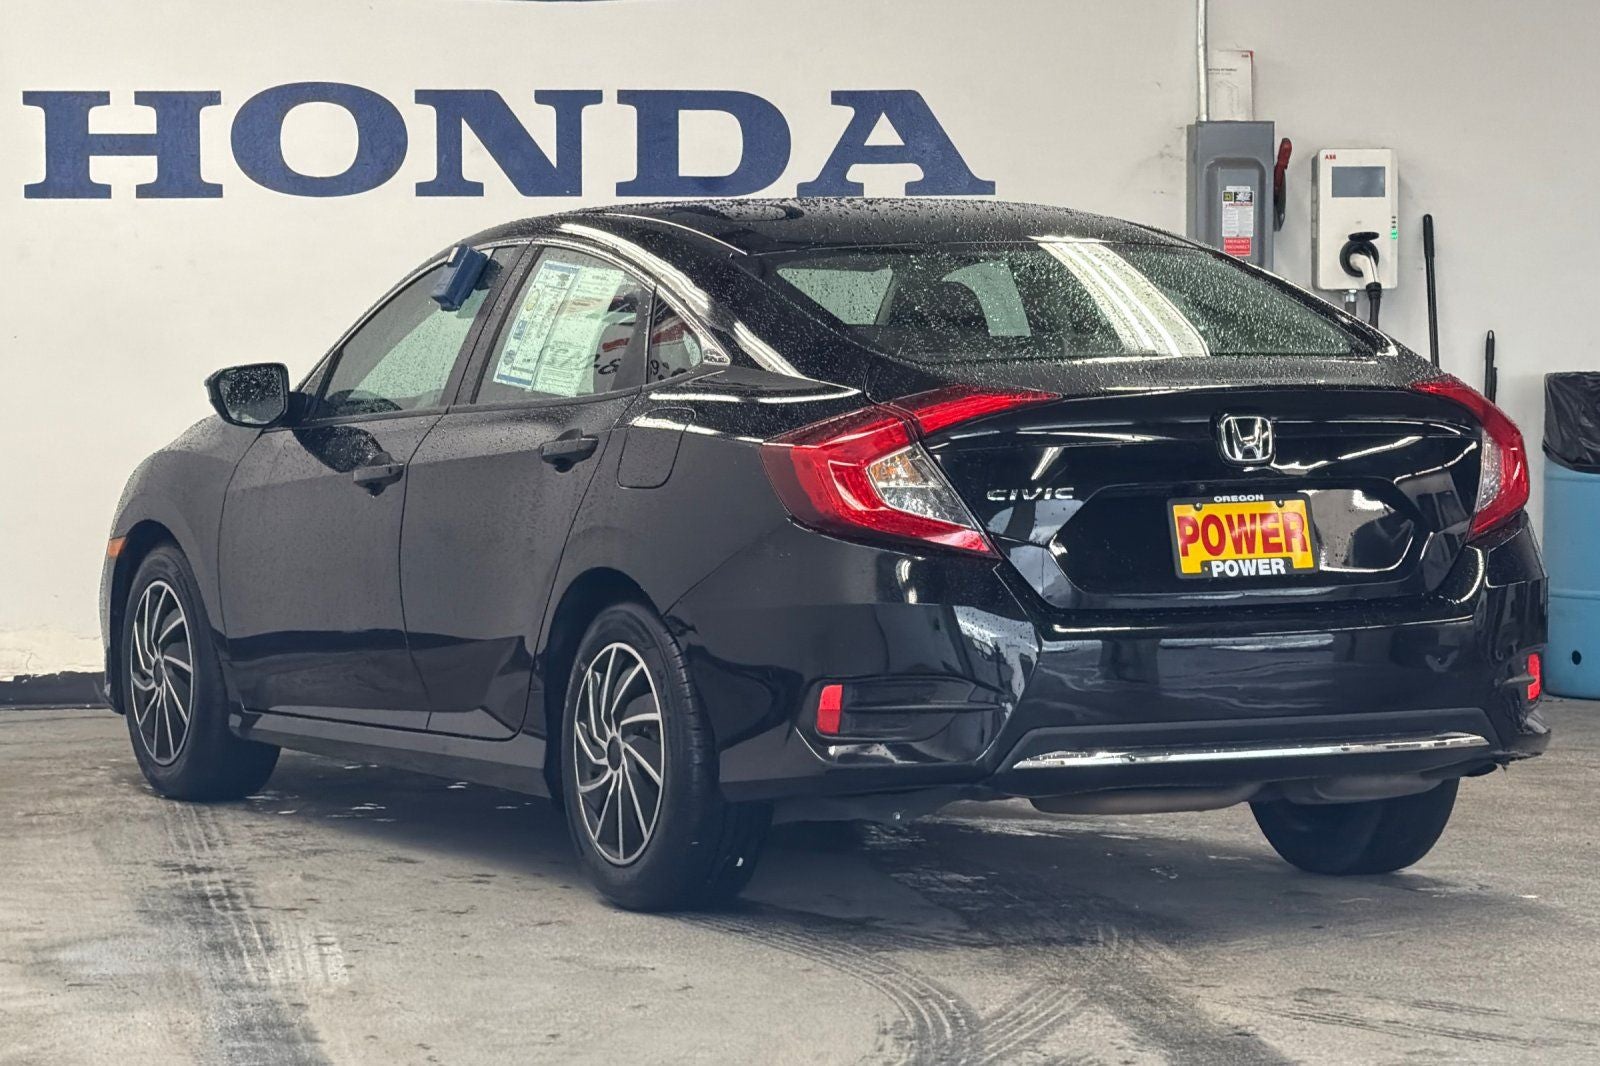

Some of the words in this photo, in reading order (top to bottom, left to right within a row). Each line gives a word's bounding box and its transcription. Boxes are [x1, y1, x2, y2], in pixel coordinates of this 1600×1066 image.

[22, 82, 996, 200] HONDA
[986, 486, 1075, 501] CIVIC
[1213, 494, 1264, 503] OREGON
[1177, 512, 1308, 557] POWER
[1211, 558, 1286, 578] POWER
